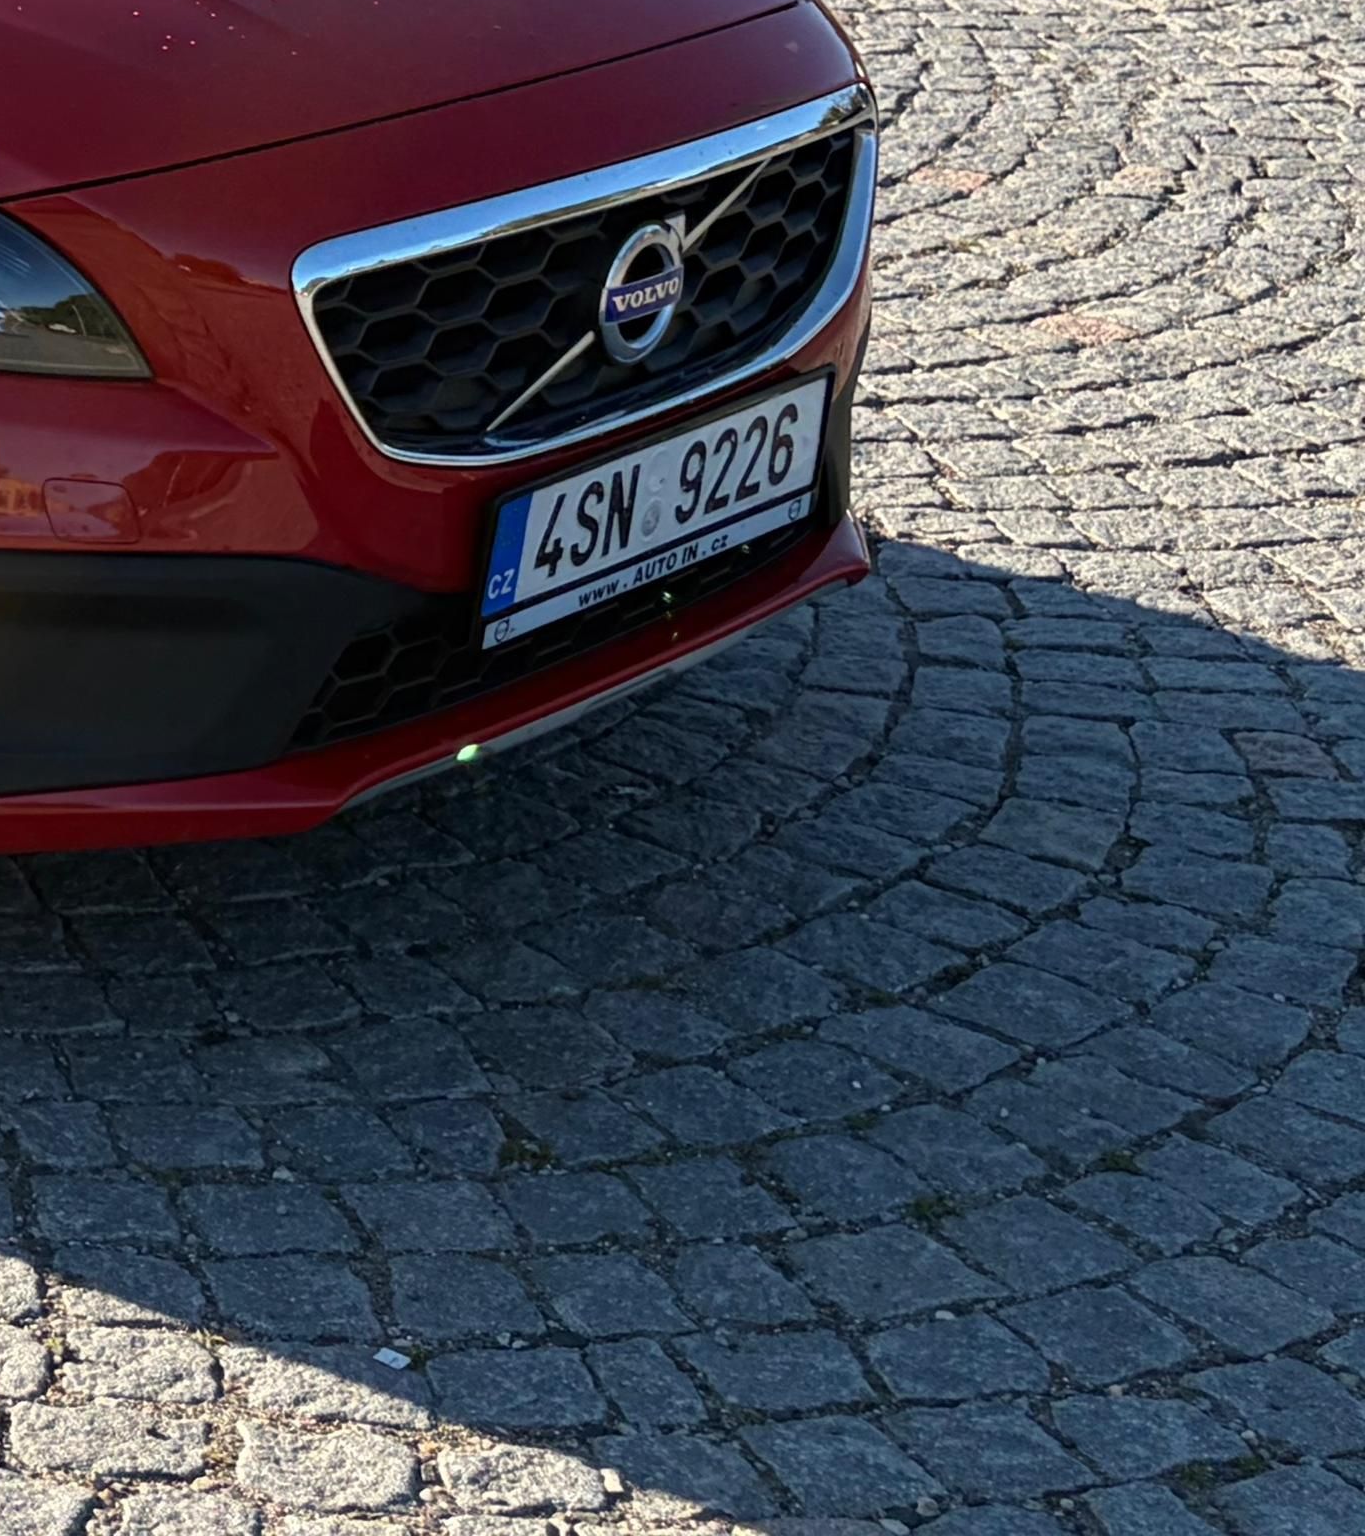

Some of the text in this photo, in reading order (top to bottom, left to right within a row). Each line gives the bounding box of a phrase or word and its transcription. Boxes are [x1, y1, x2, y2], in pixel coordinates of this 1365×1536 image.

[612, 277, 680, 312] VOLVO
[534, 403, 799, 579] 4SN 9226
[487, 568, 516, 599] CZ
